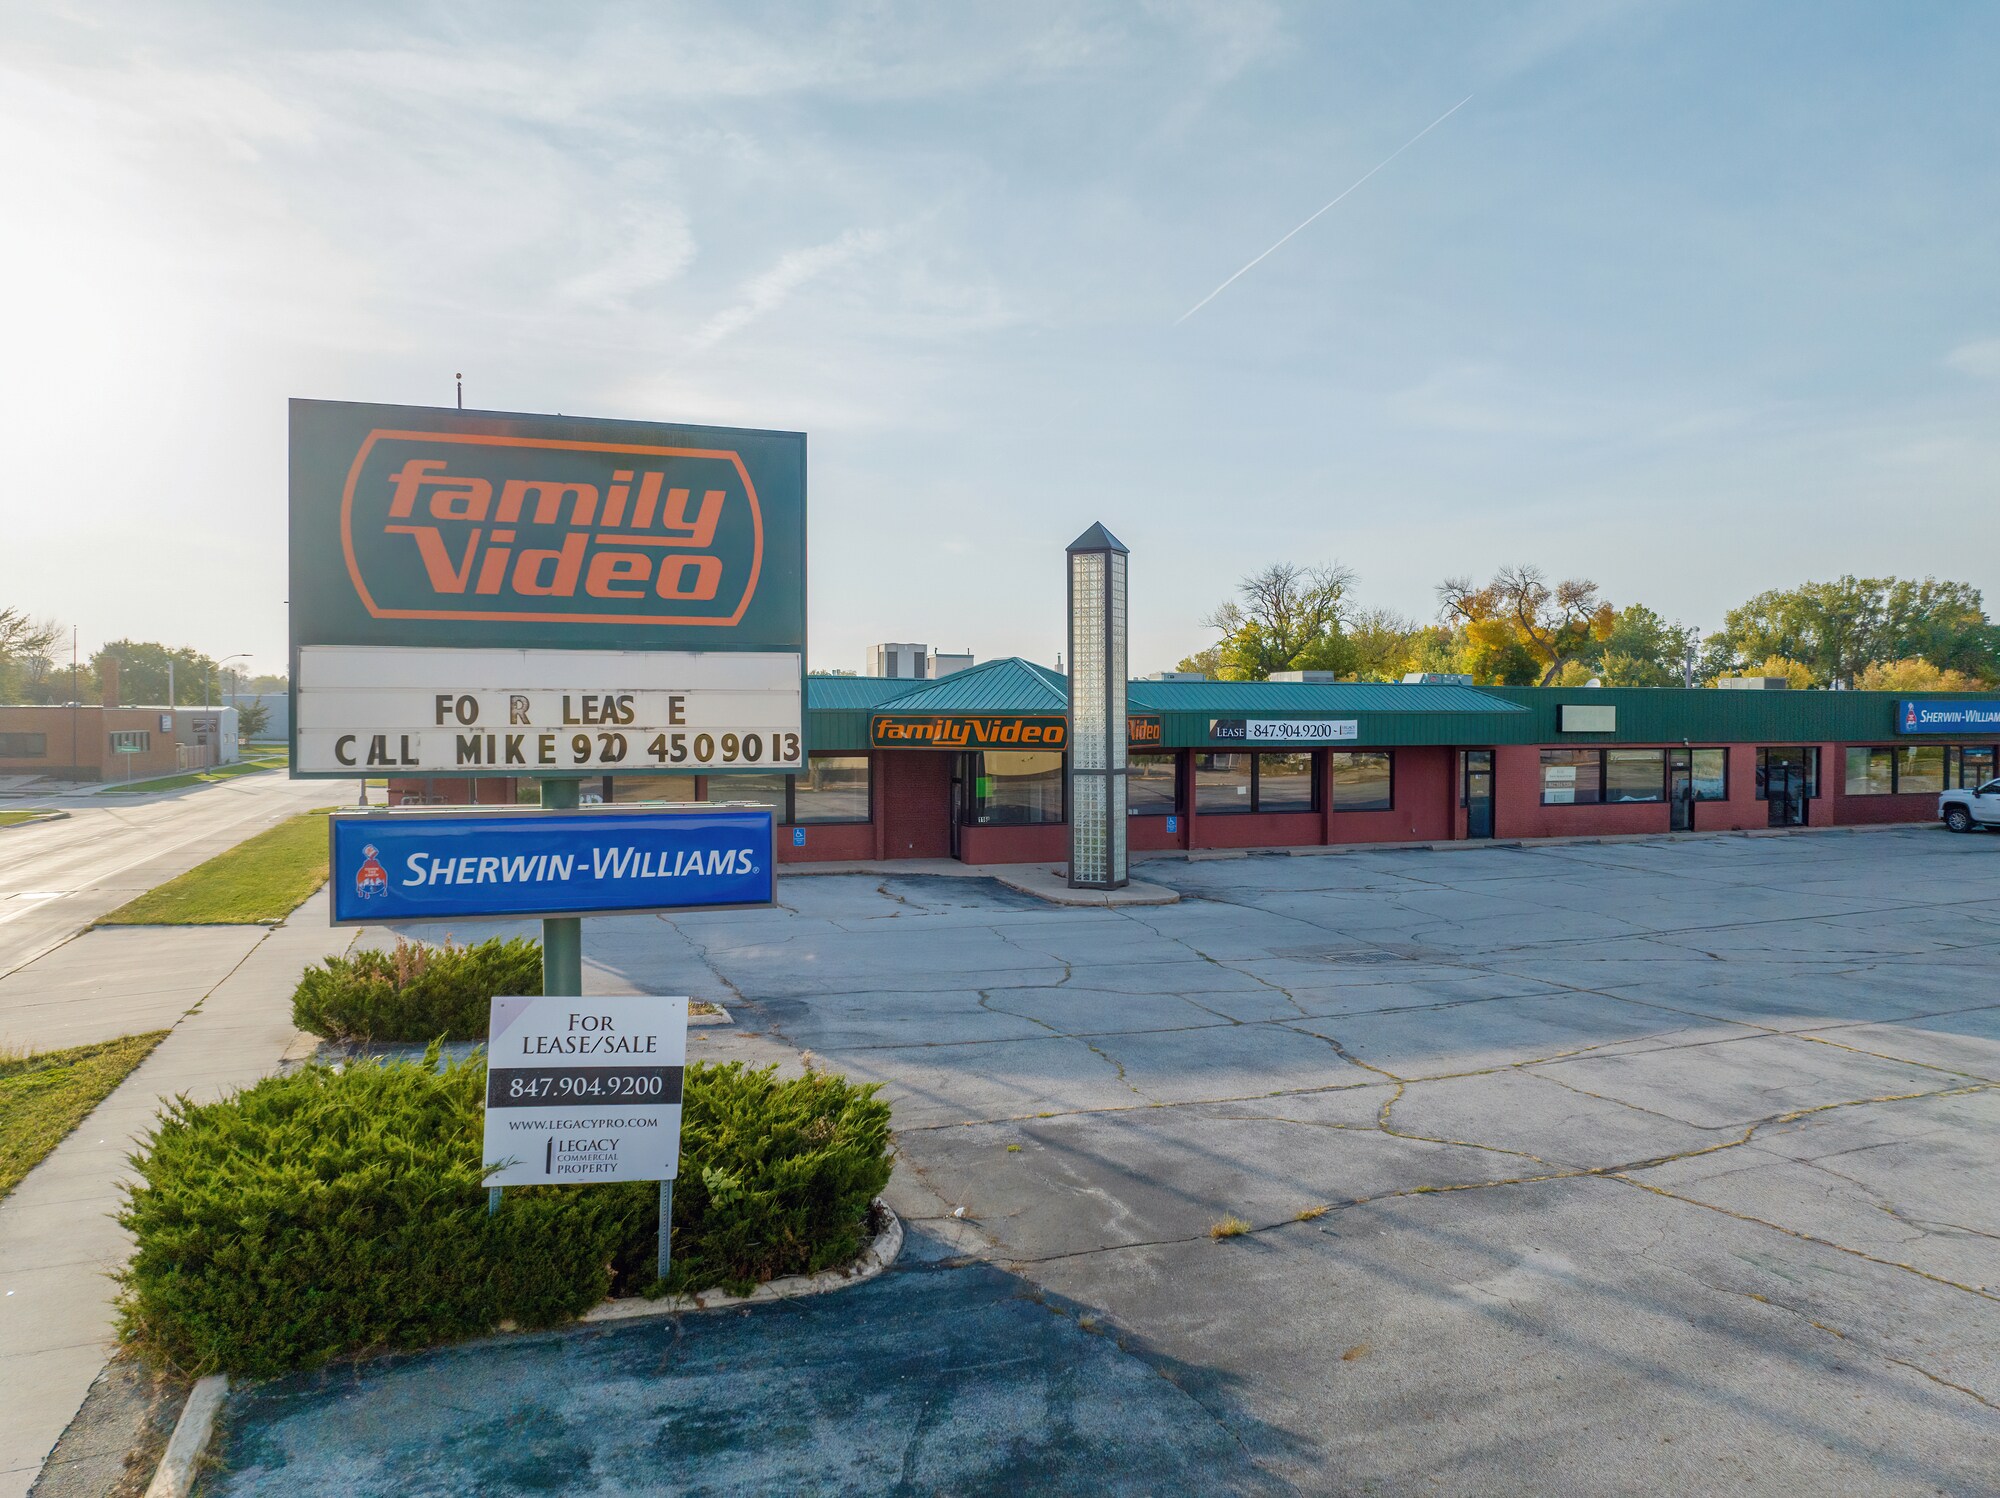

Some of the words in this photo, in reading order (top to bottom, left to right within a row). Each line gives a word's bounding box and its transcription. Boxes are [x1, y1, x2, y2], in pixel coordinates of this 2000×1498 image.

[386, 459, 727, 548] family
[384, 525, 723, 601] Video
[1920, 709, 2000, 723] SHERWIN-WILLIAM
[1254, 723, 1331, 738] 847.904.9200
[334, 734, 420, 767] CALL
[456, 734, 556, 765] MIKE
[568, 1013, 615, 1032] FOR
[522, 1035, 657, 1054] LEASE/SALE
[509, 1076, 663, 1098] 847.904.9200
[509, 1118, 658, 1130] WWW.LEGACYPRO.COM
[559, 1138, 620, 1152] LEGACY
[557, 1153, 618, 1162] COMMERCIAL
[557, 1163, 618, 1174] PROPERTY
